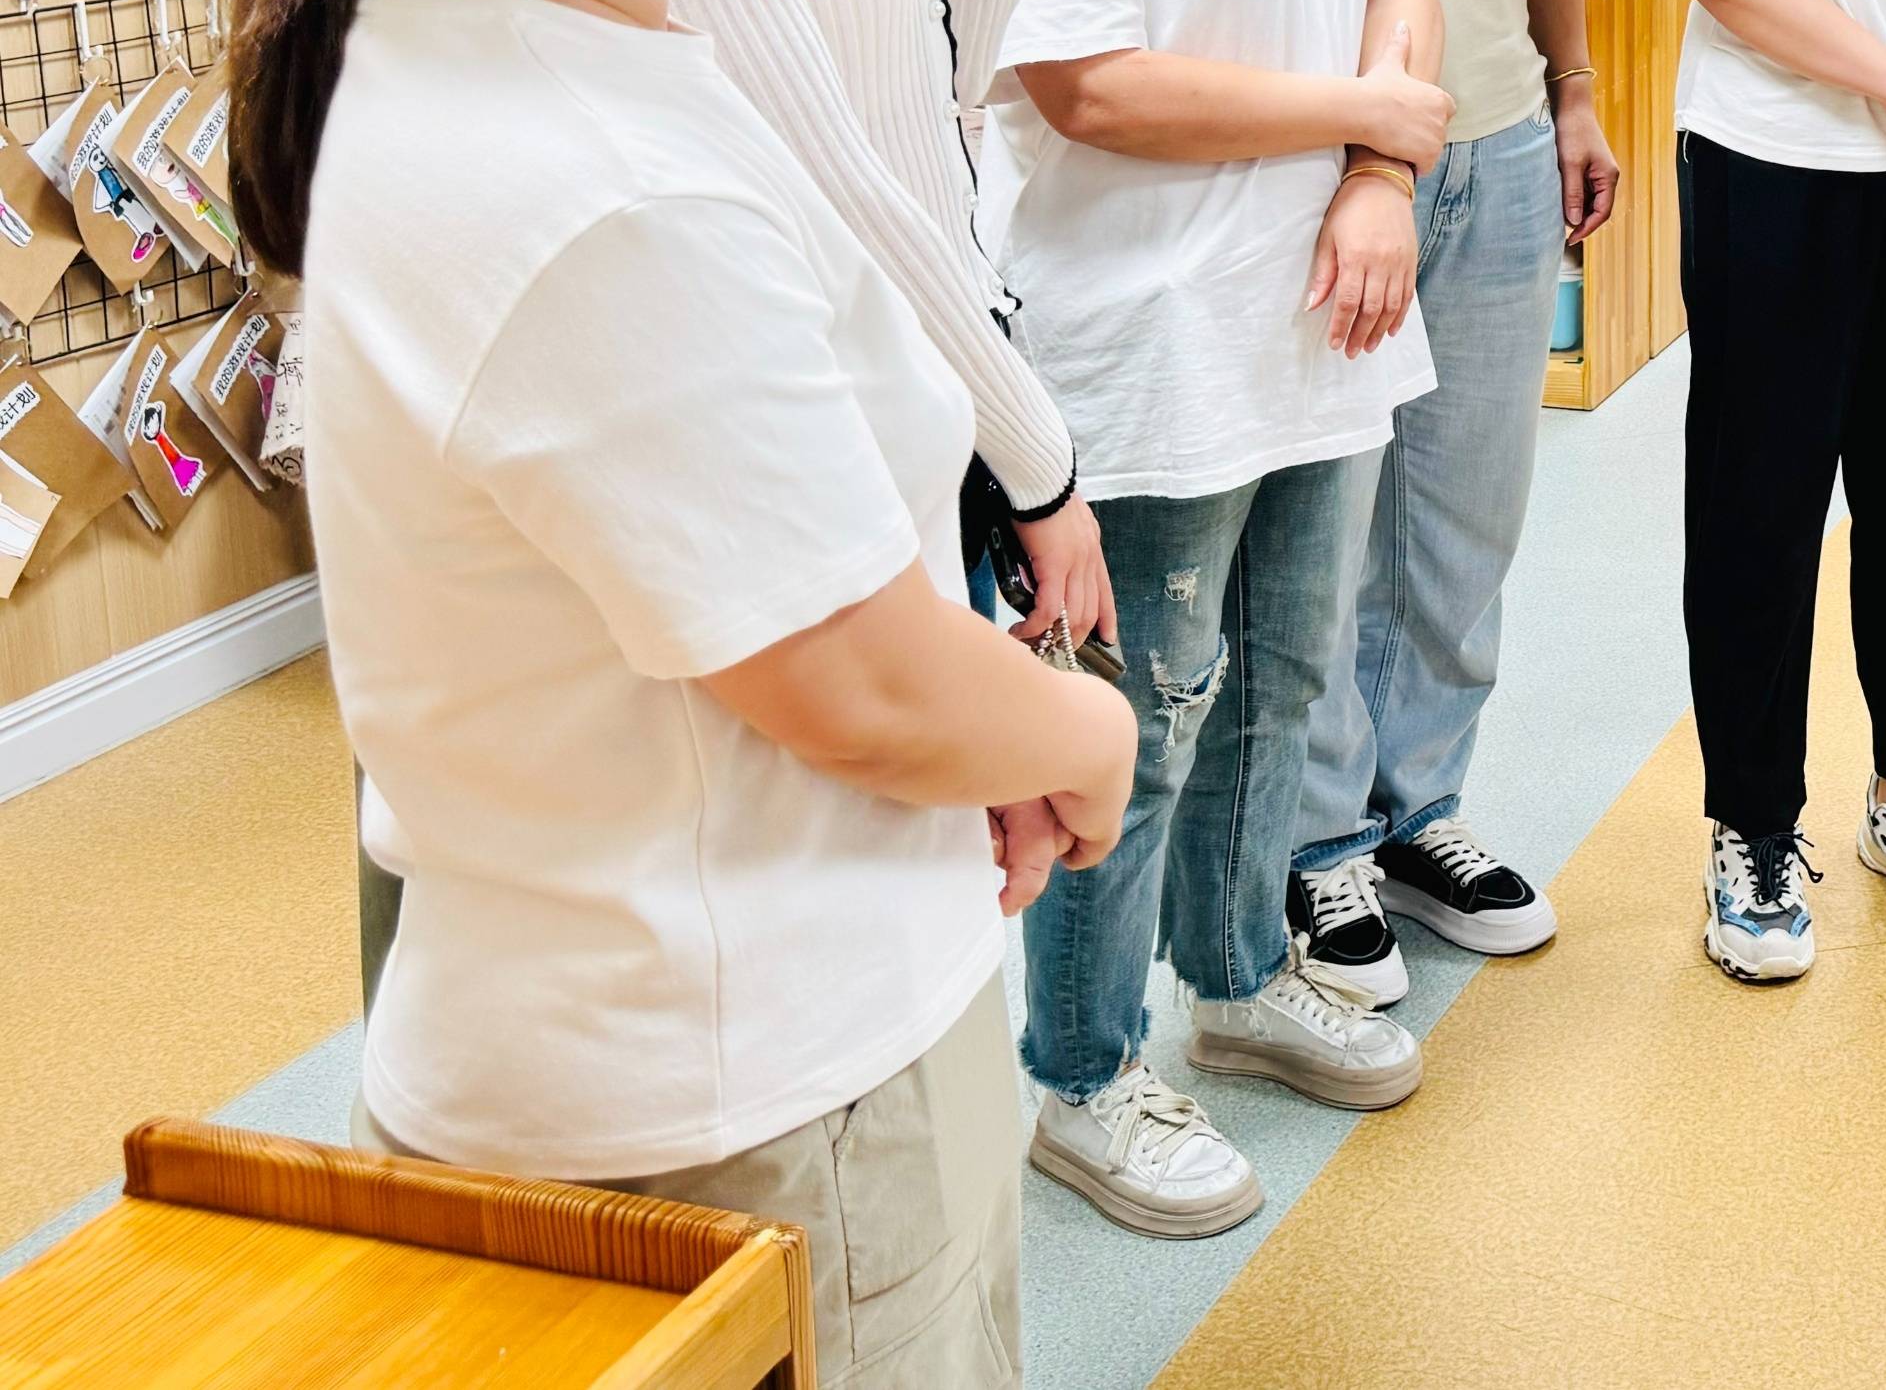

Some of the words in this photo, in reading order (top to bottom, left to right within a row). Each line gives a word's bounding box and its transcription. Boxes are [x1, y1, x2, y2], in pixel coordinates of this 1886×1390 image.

[216, 314, 265, 398] 我的游戏计划
